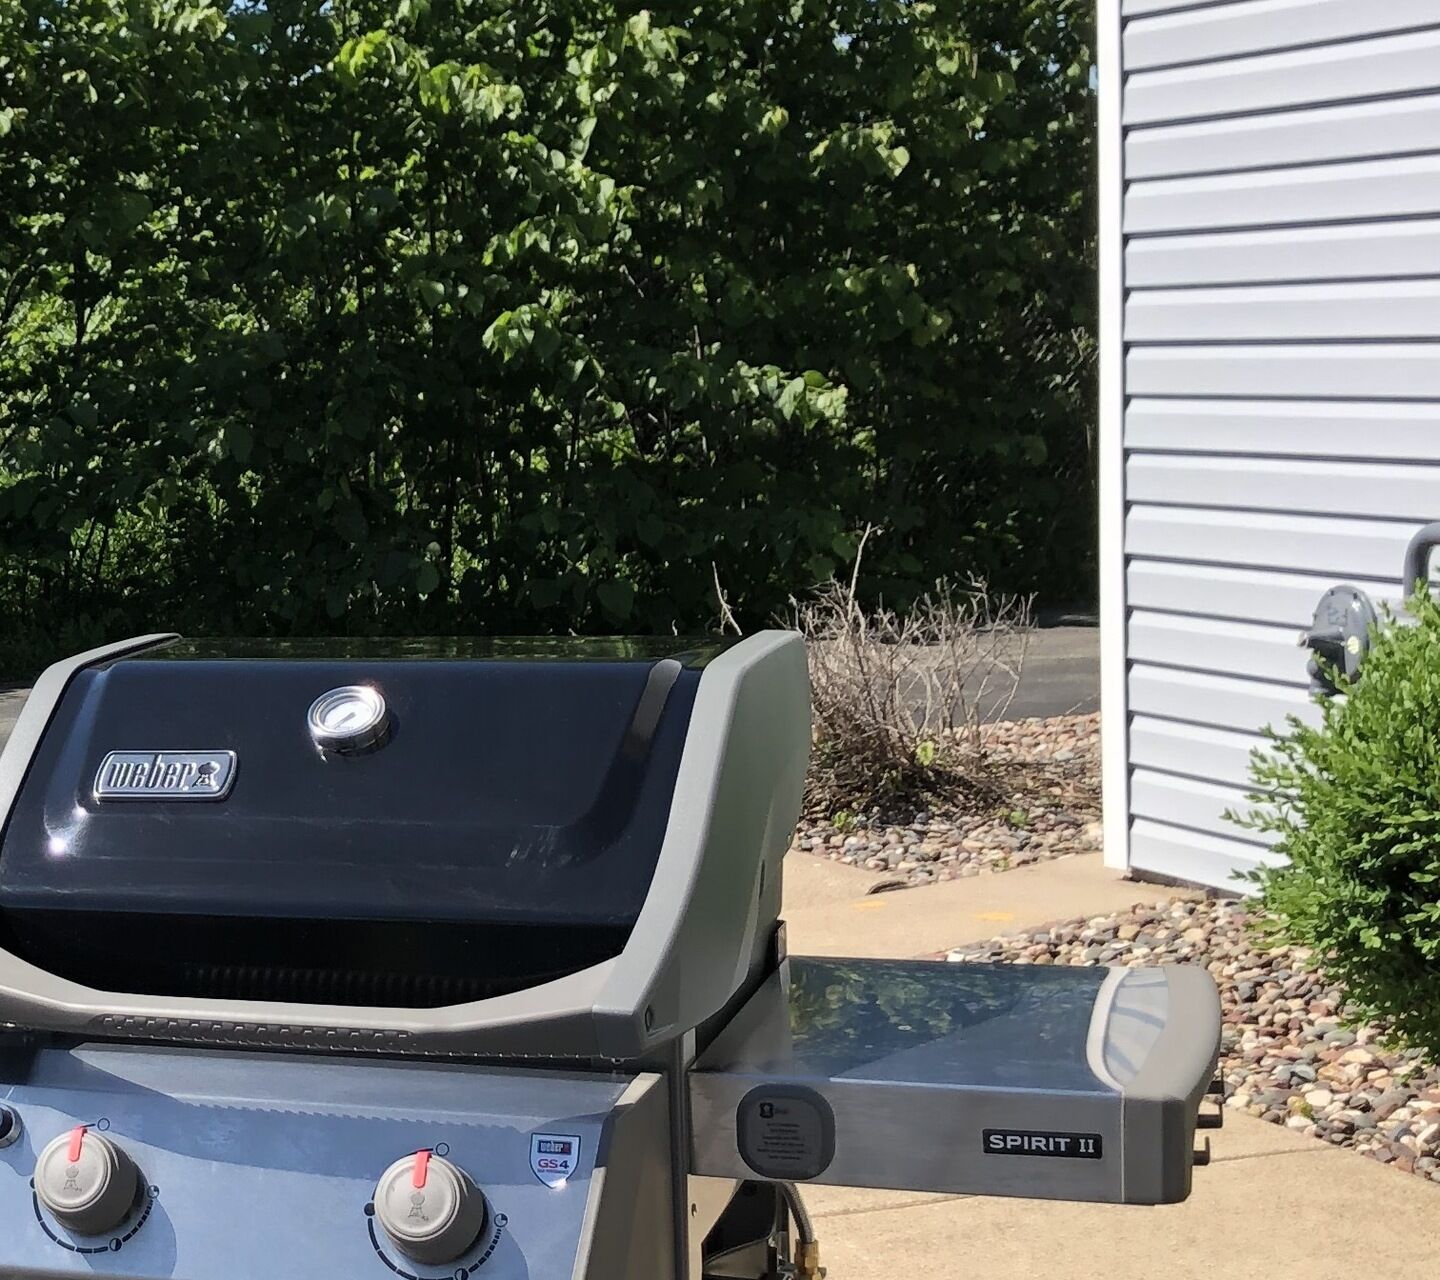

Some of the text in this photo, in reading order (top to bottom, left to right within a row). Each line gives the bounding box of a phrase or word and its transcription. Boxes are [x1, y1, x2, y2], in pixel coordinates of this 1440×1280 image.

[107, 753, 197, 789] weber
[988, 1134, 1095, 1153] SPIRIT II
